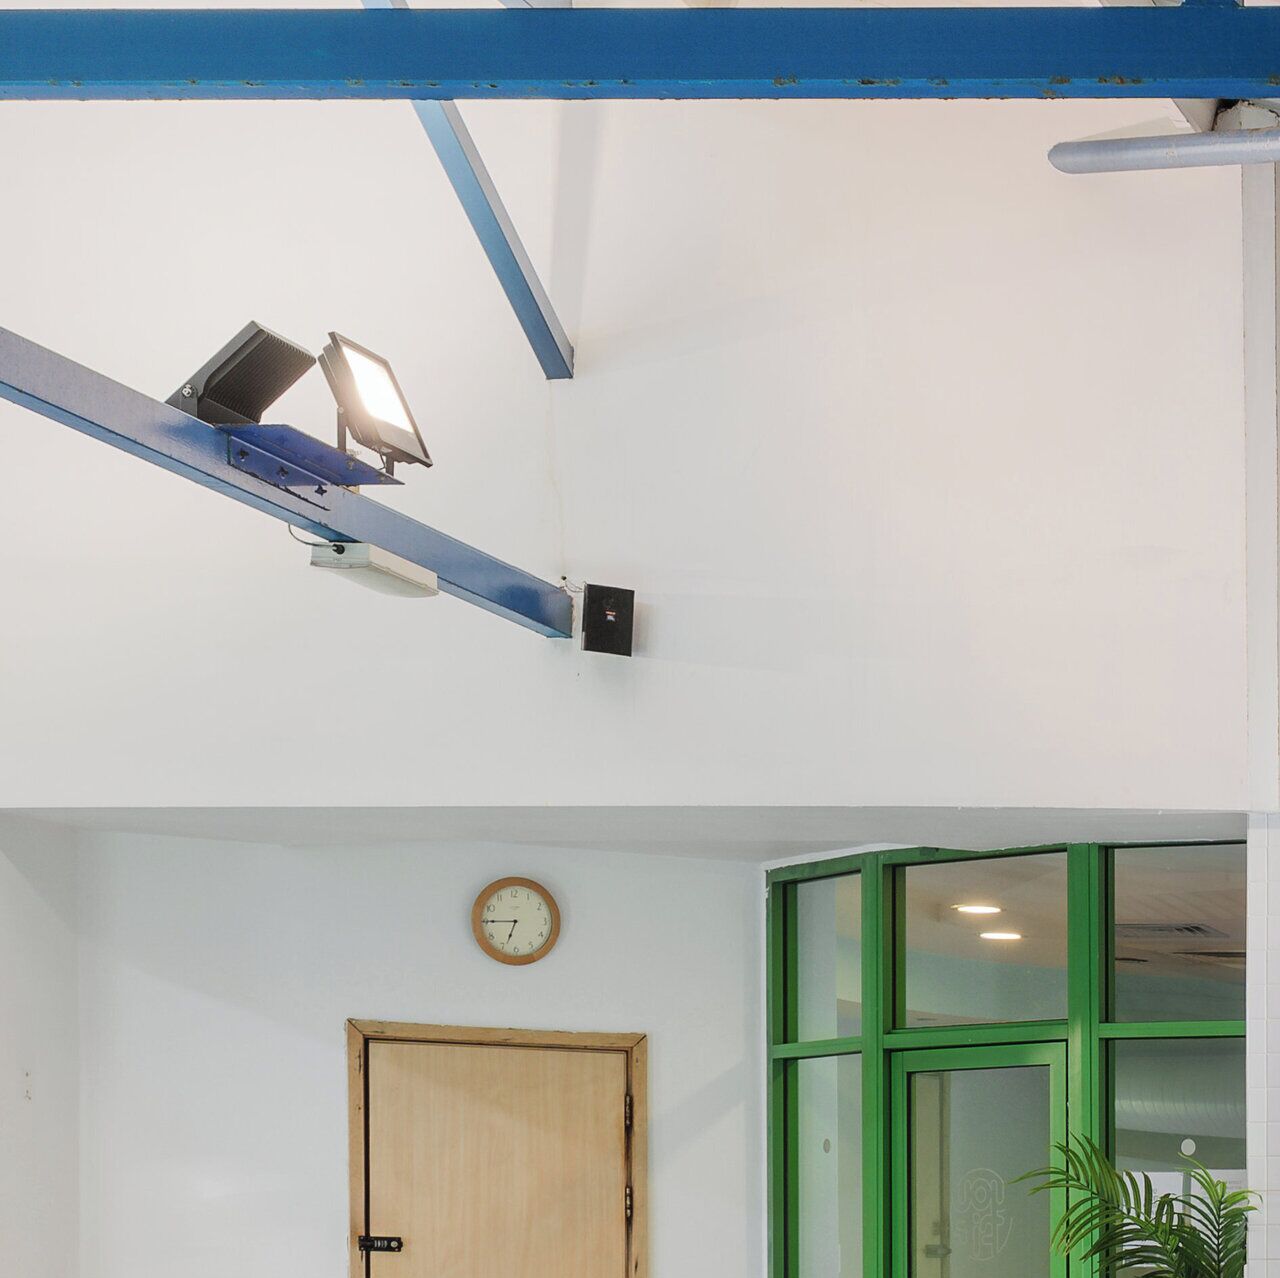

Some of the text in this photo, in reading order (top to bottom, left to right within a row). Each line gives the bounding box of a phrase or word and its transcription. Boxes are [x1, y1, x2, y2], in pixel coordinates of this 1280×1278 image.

[510, 889, 518, 898] 12
[486, 904, 496, 912] 10
[537, 902, 542, 911] 2
[488, 932, 495, 940] 8
[500, 942, 505, 950] 7
[528, 941, 533, 949] 5
